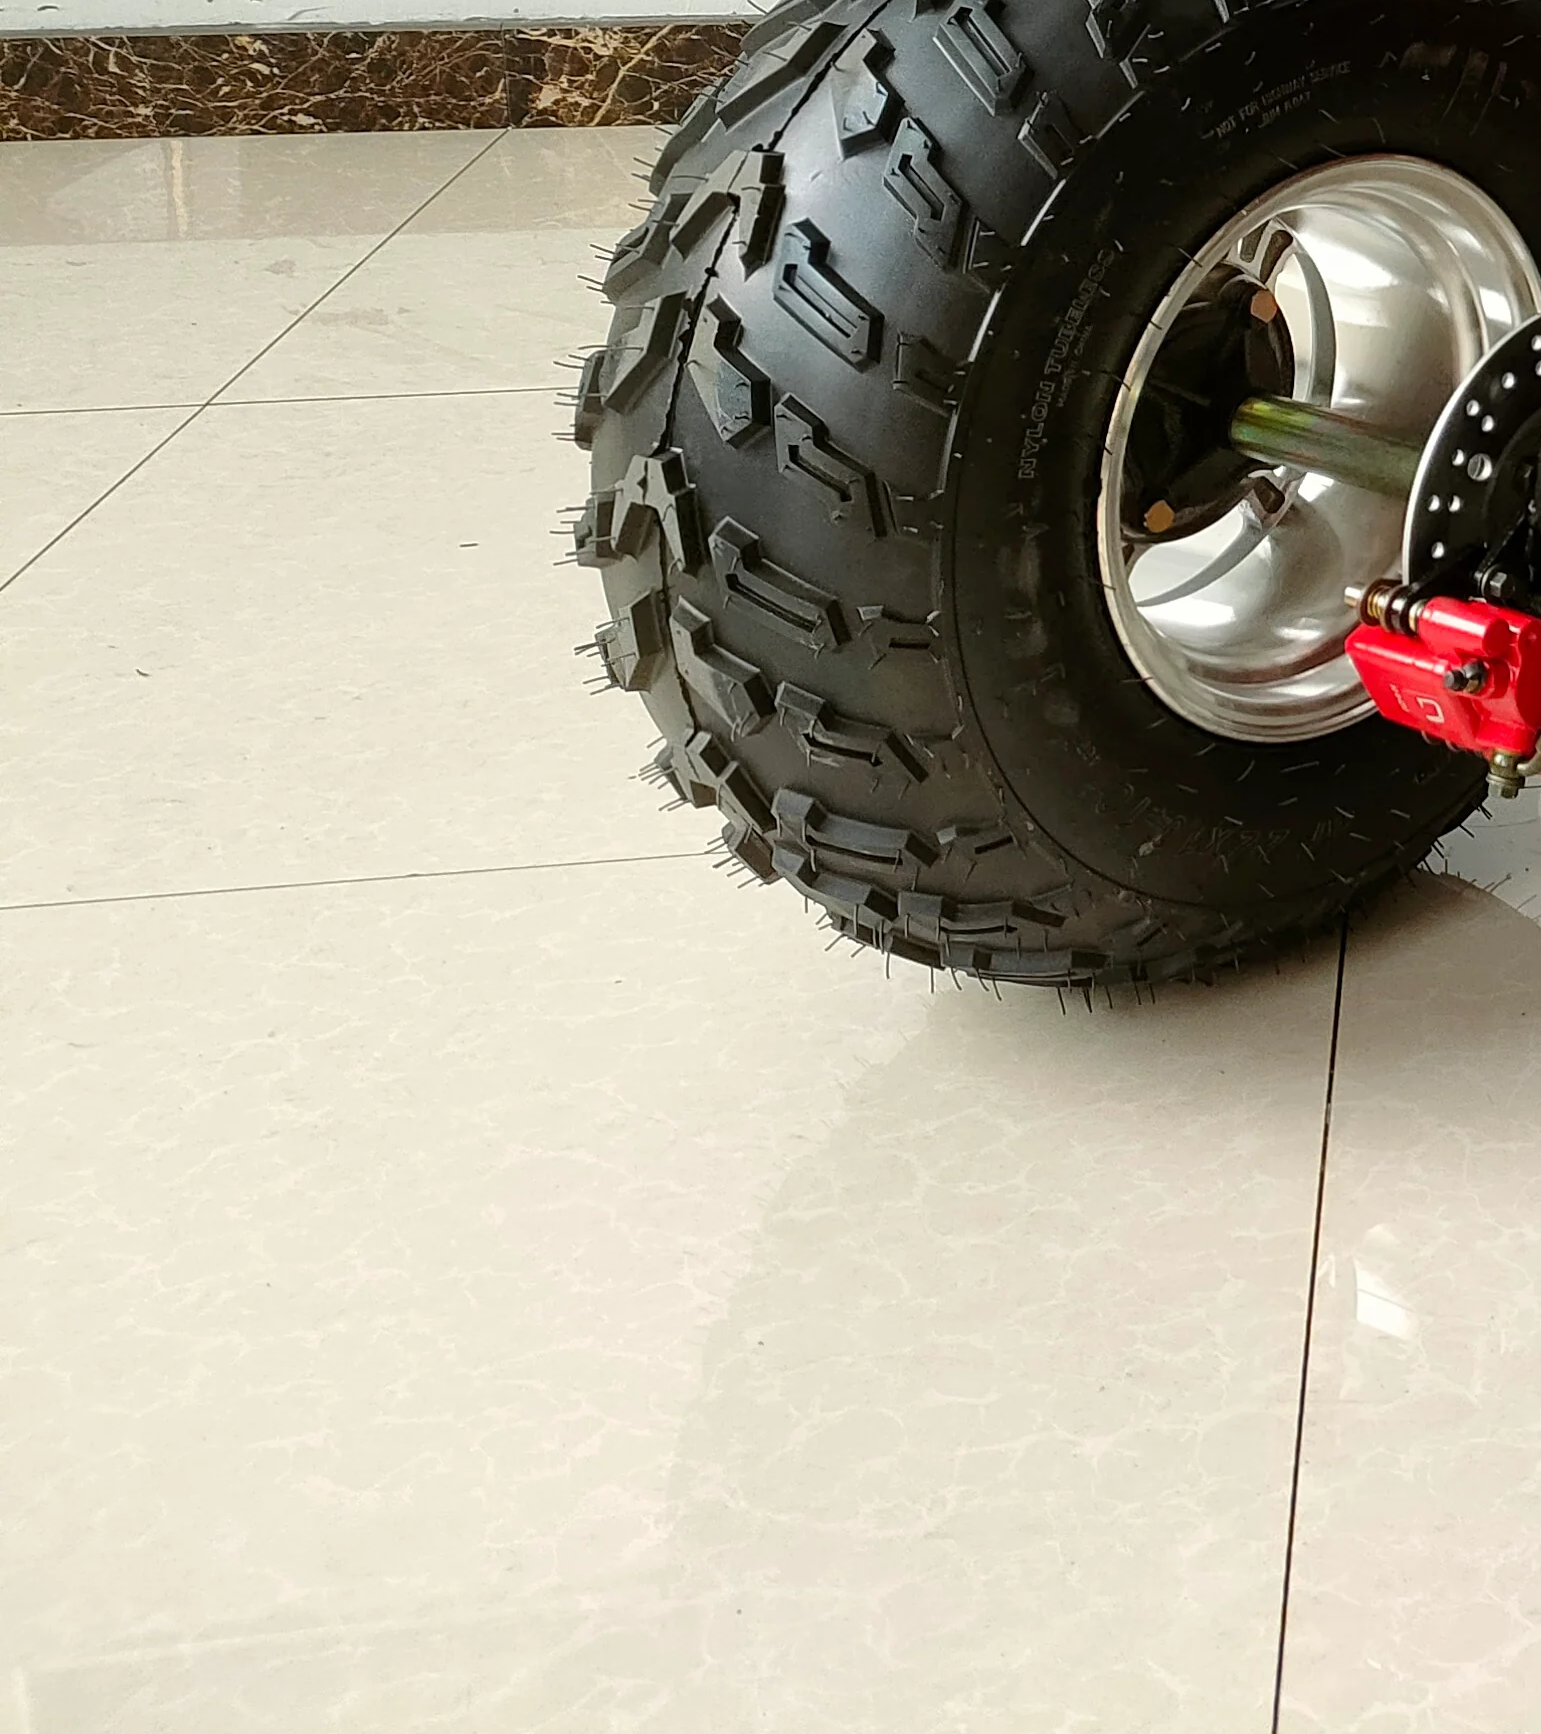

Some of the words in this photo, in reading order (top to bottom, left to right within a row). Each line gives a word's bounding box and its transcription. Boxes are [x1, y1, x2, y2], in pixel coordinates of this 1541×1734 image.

[1215, 115, 1237, 138] NOT
[1238, 100, 1260, 121] FOR
[1018, 381, 1056, 479] NYLON
[1044, 249, 1115, 376] TUBELESS
